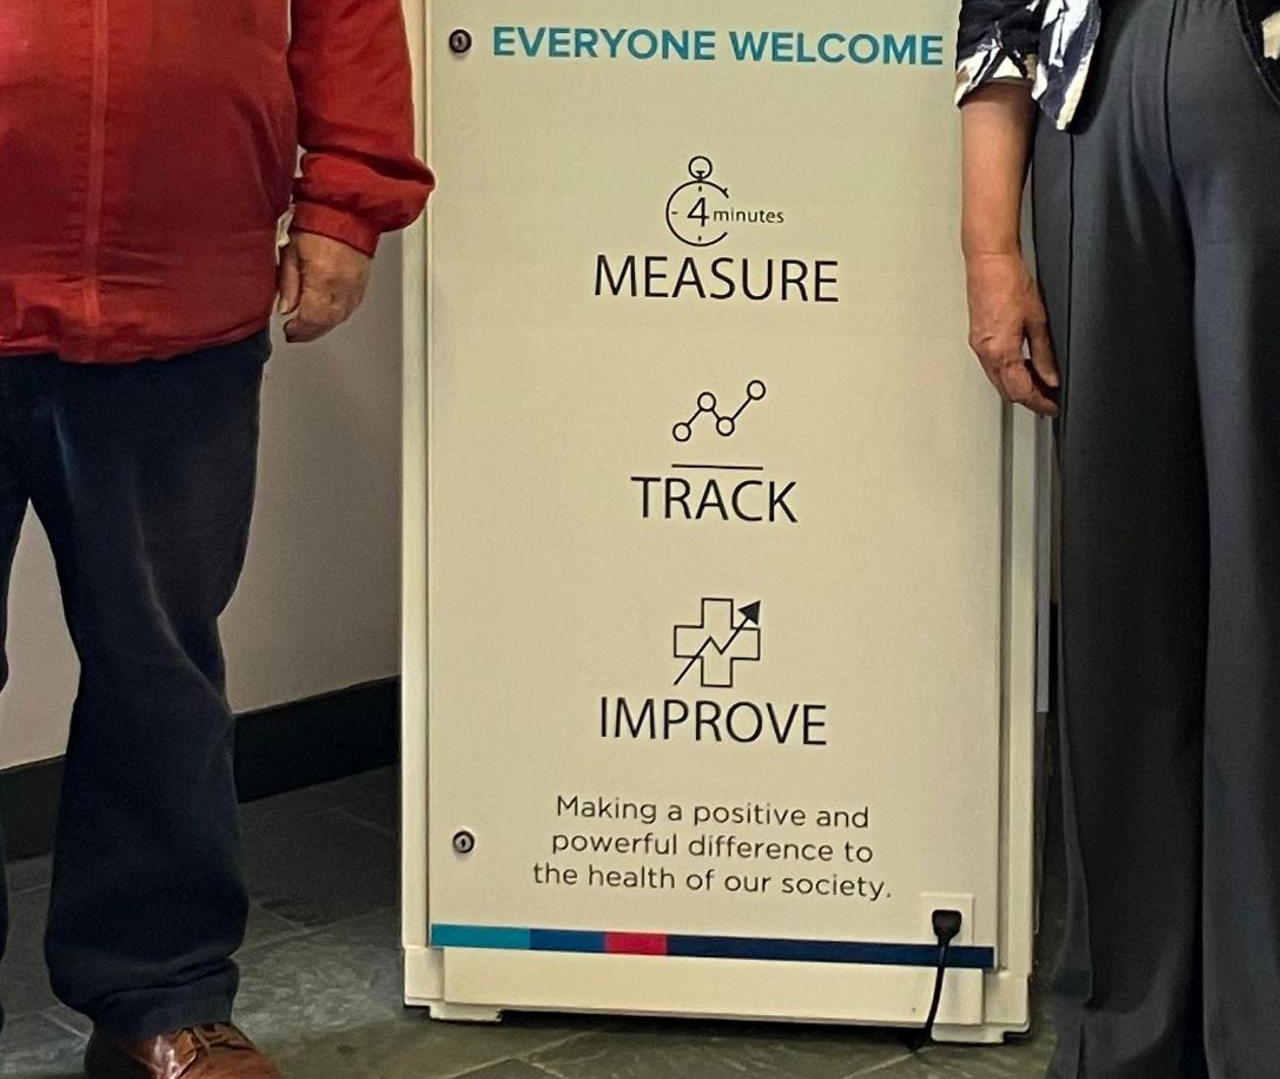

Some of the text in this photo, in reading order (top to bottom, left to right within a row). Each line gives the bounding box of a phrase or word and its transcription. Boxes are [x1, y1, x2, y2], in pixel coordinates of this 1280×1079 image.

[493, 26, 943, 65] EVERYONE WELCOME
[687, 197, 784, 227] 4 minutes
[594, 254, 839, 303] MEASURE
[630, 476, 797, 523] TRACK
[601, 696, 827, 746] IMPROVE
[557, 795, 869, 829] Making a positive and
[552, 832, 873, 863] powerful difference to
[533, 862, 892, 902] the health of our society.
